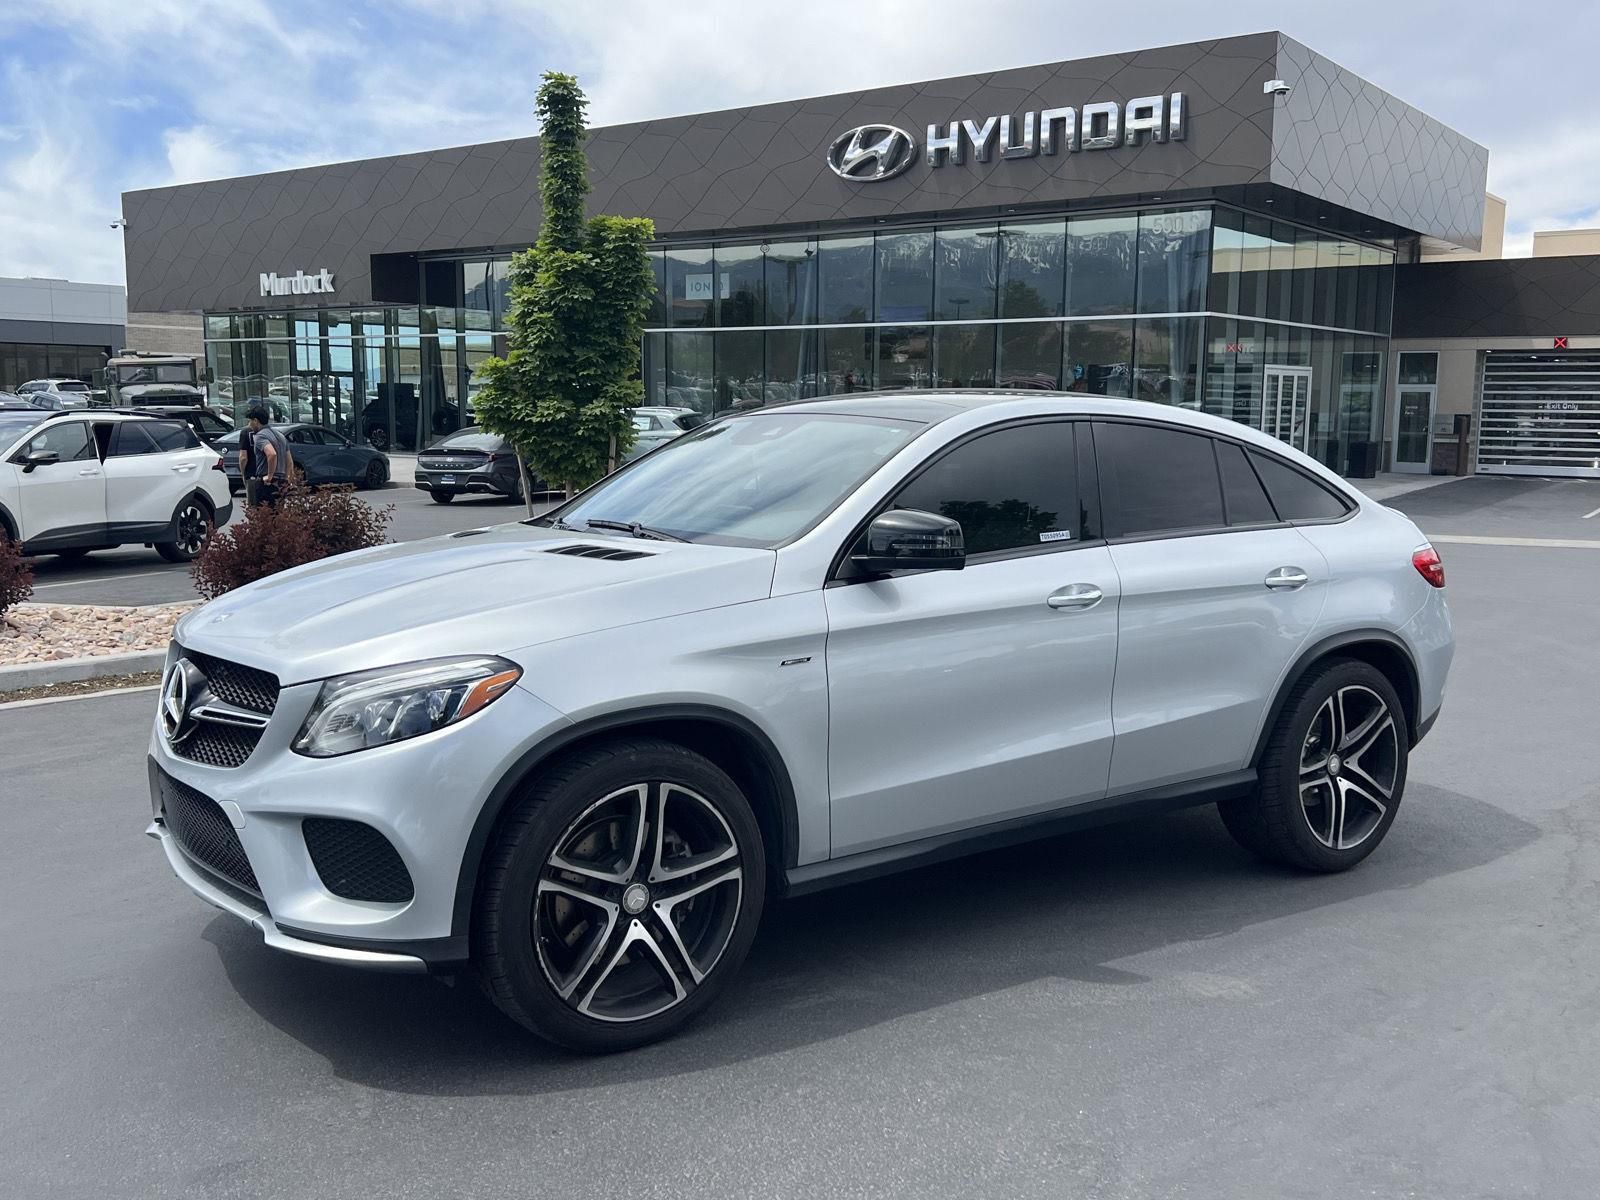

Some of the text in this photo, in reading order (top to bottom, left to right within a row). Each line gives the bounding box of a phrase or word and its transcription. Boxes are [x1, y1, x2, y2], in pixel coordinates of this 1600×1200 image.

[926, 92, 1187, 168] HYUNDAI
[260, 268, 335, 297] Murdock
[690, 281, 724, 292] ION
